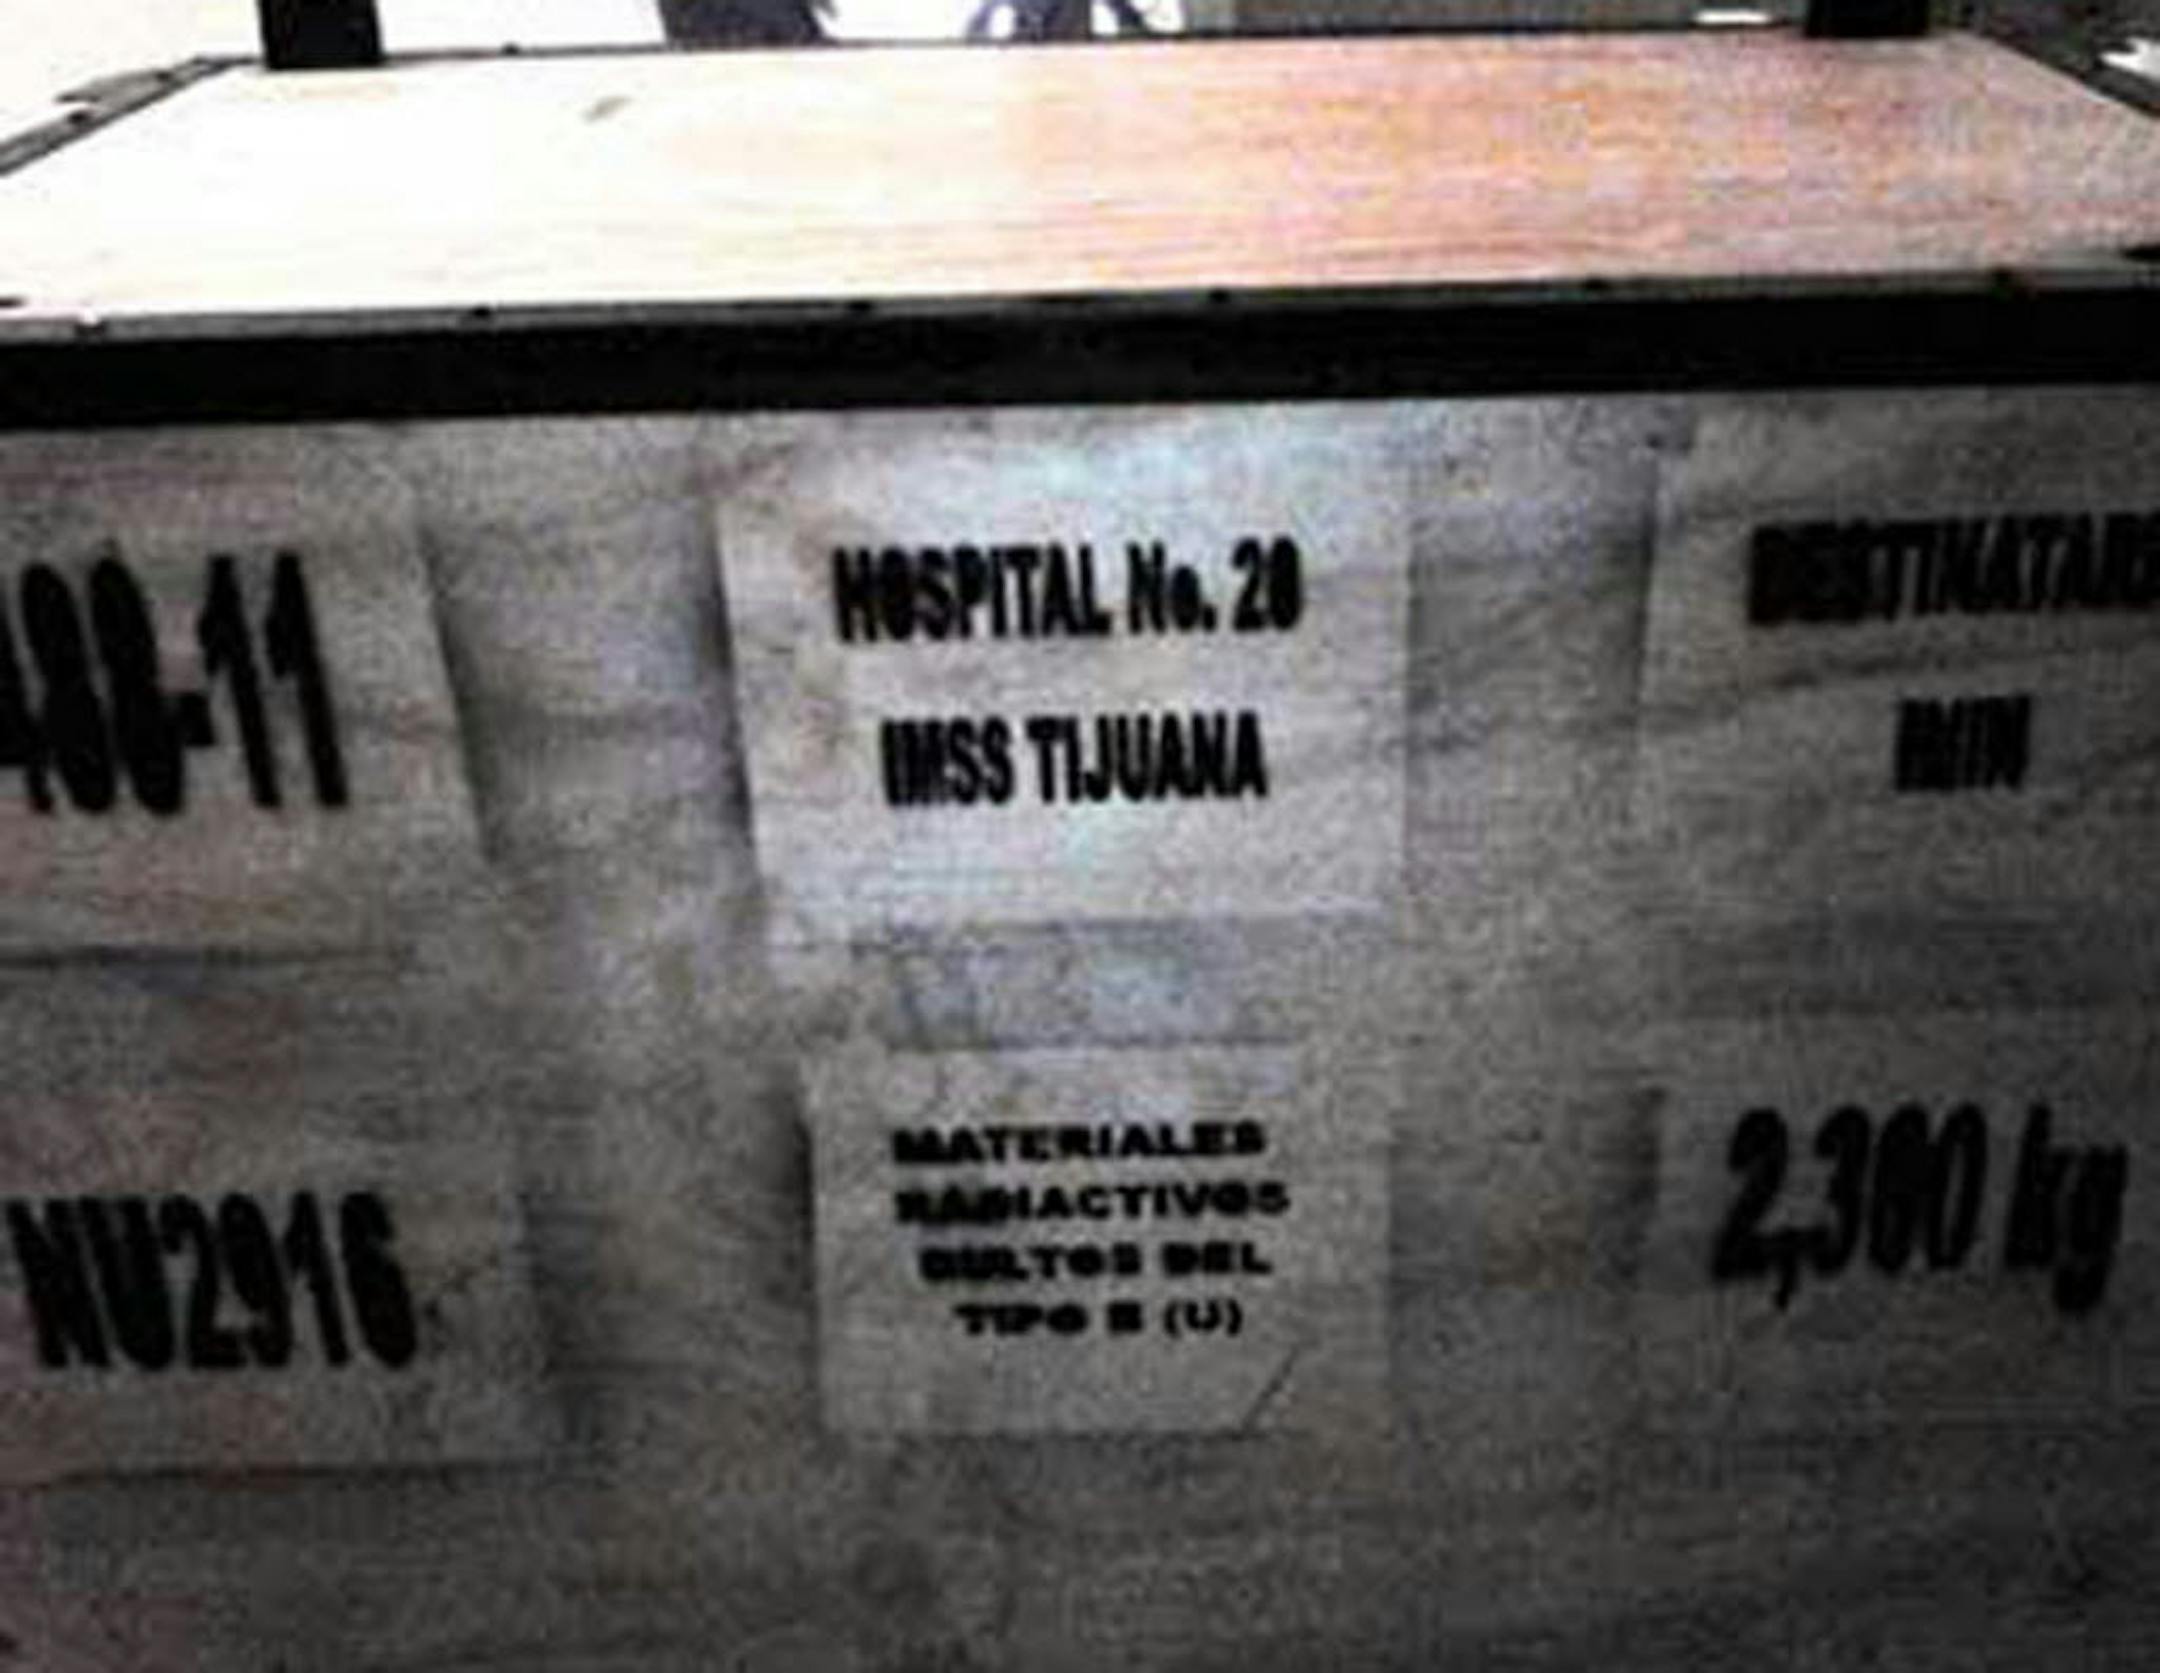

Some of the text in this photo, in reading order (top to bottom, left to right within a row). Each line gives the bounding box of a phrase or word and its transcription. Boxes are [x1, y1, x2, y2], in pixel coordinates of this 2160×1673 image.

[831, 543, 1113, 642] HOSPITAL
[1126, 540, 1219, 636] No.
[880, 709, 1269, 807] IMSS TIJUANA
[892, 1119, 1266, 1164] MATERIALES
[894, 1180, 1291, 1226] RADIACTIVOS
[2003, 1104, 2128, 1314] kg
[5, 1191, 418, 1372] NU2916
[917, 1240, 1273, 1283] BULTOS DEL
[952, 1301, 1089, 1338] TIPO
[1163, 1298, 1244, 1338] (U)
